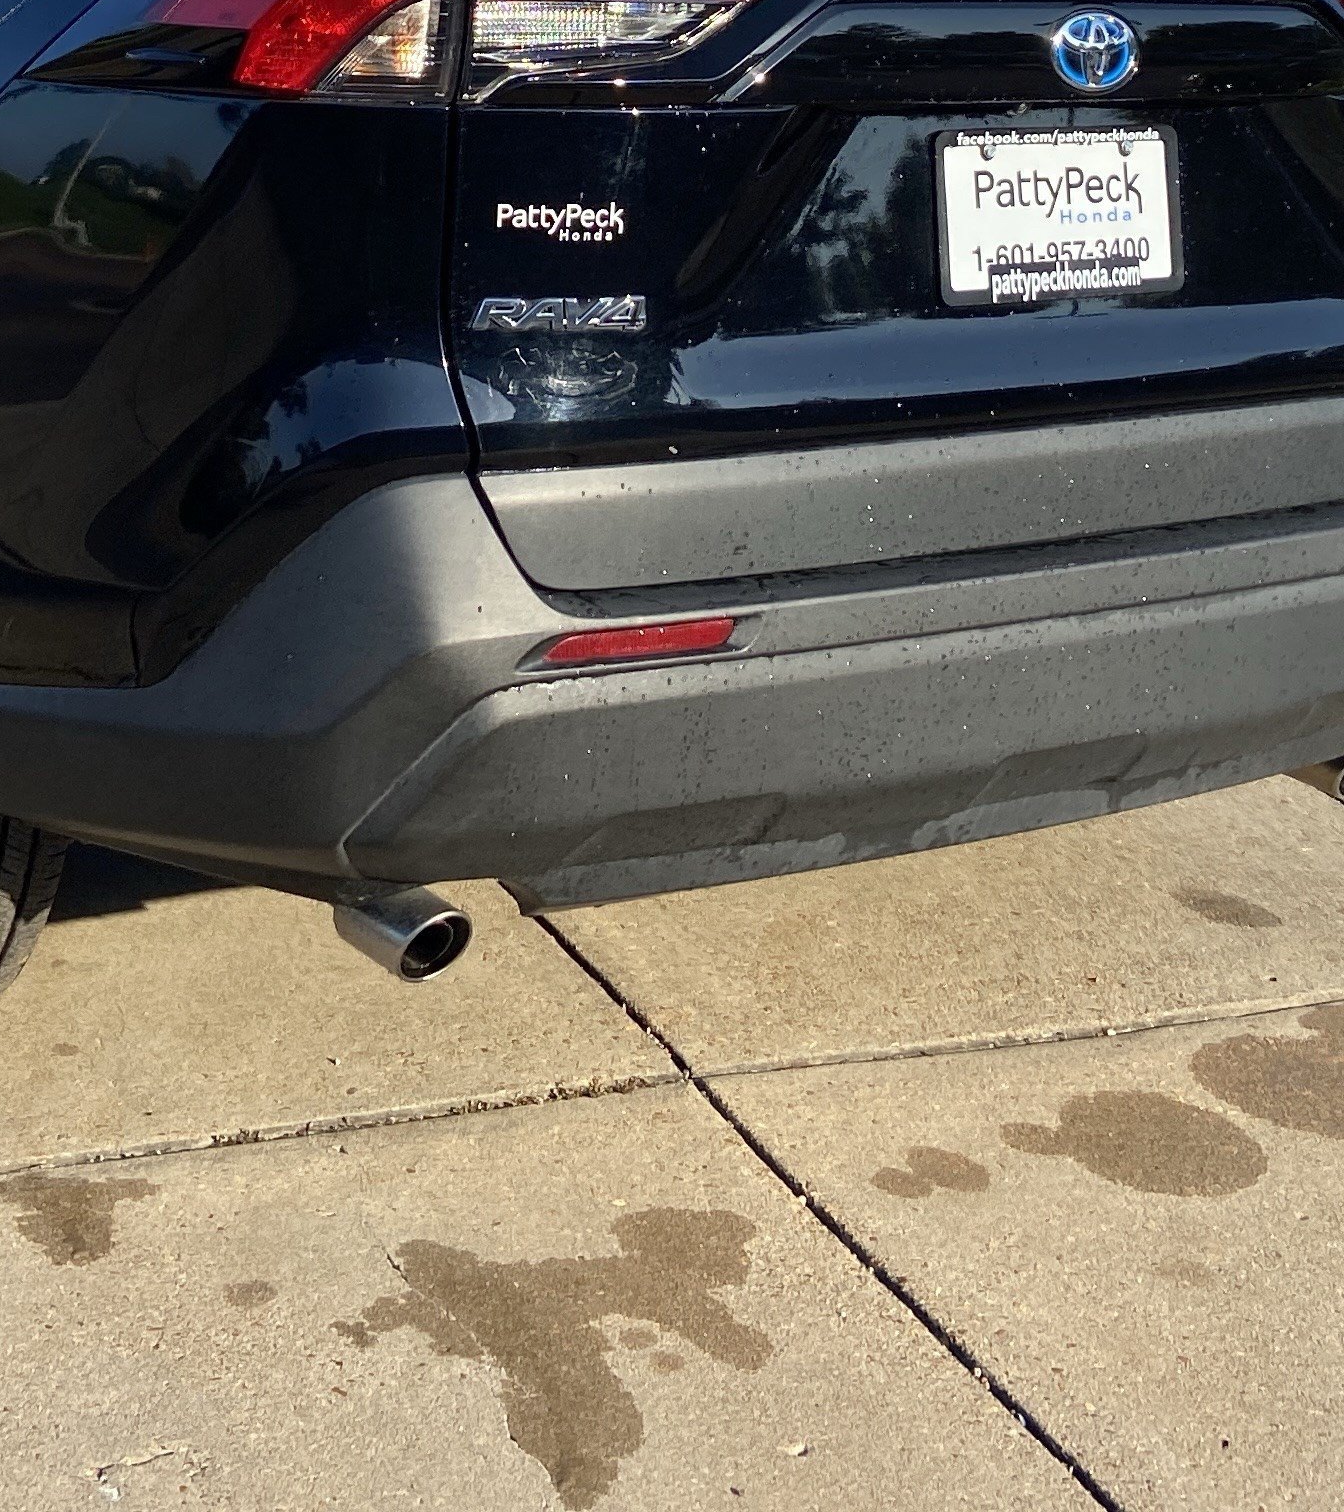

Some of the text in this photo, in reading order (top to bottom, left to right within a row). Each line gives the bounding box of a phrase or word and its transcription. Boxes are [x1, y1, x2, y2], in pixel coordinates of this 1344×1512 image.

[957, 127, 1159, 146] facebook.com/pattypeckhonda
[974, 162, 1143, 218] PattyPeck
[496, 202, 625, 235] PattyPeck
[1060, 206, 1132, 225] Honda
[558, 228, 613, 241] Honda
[991, 262, 1141, 303] pattypeckhonda.com
[469, 294, 647, 331] RAV4
